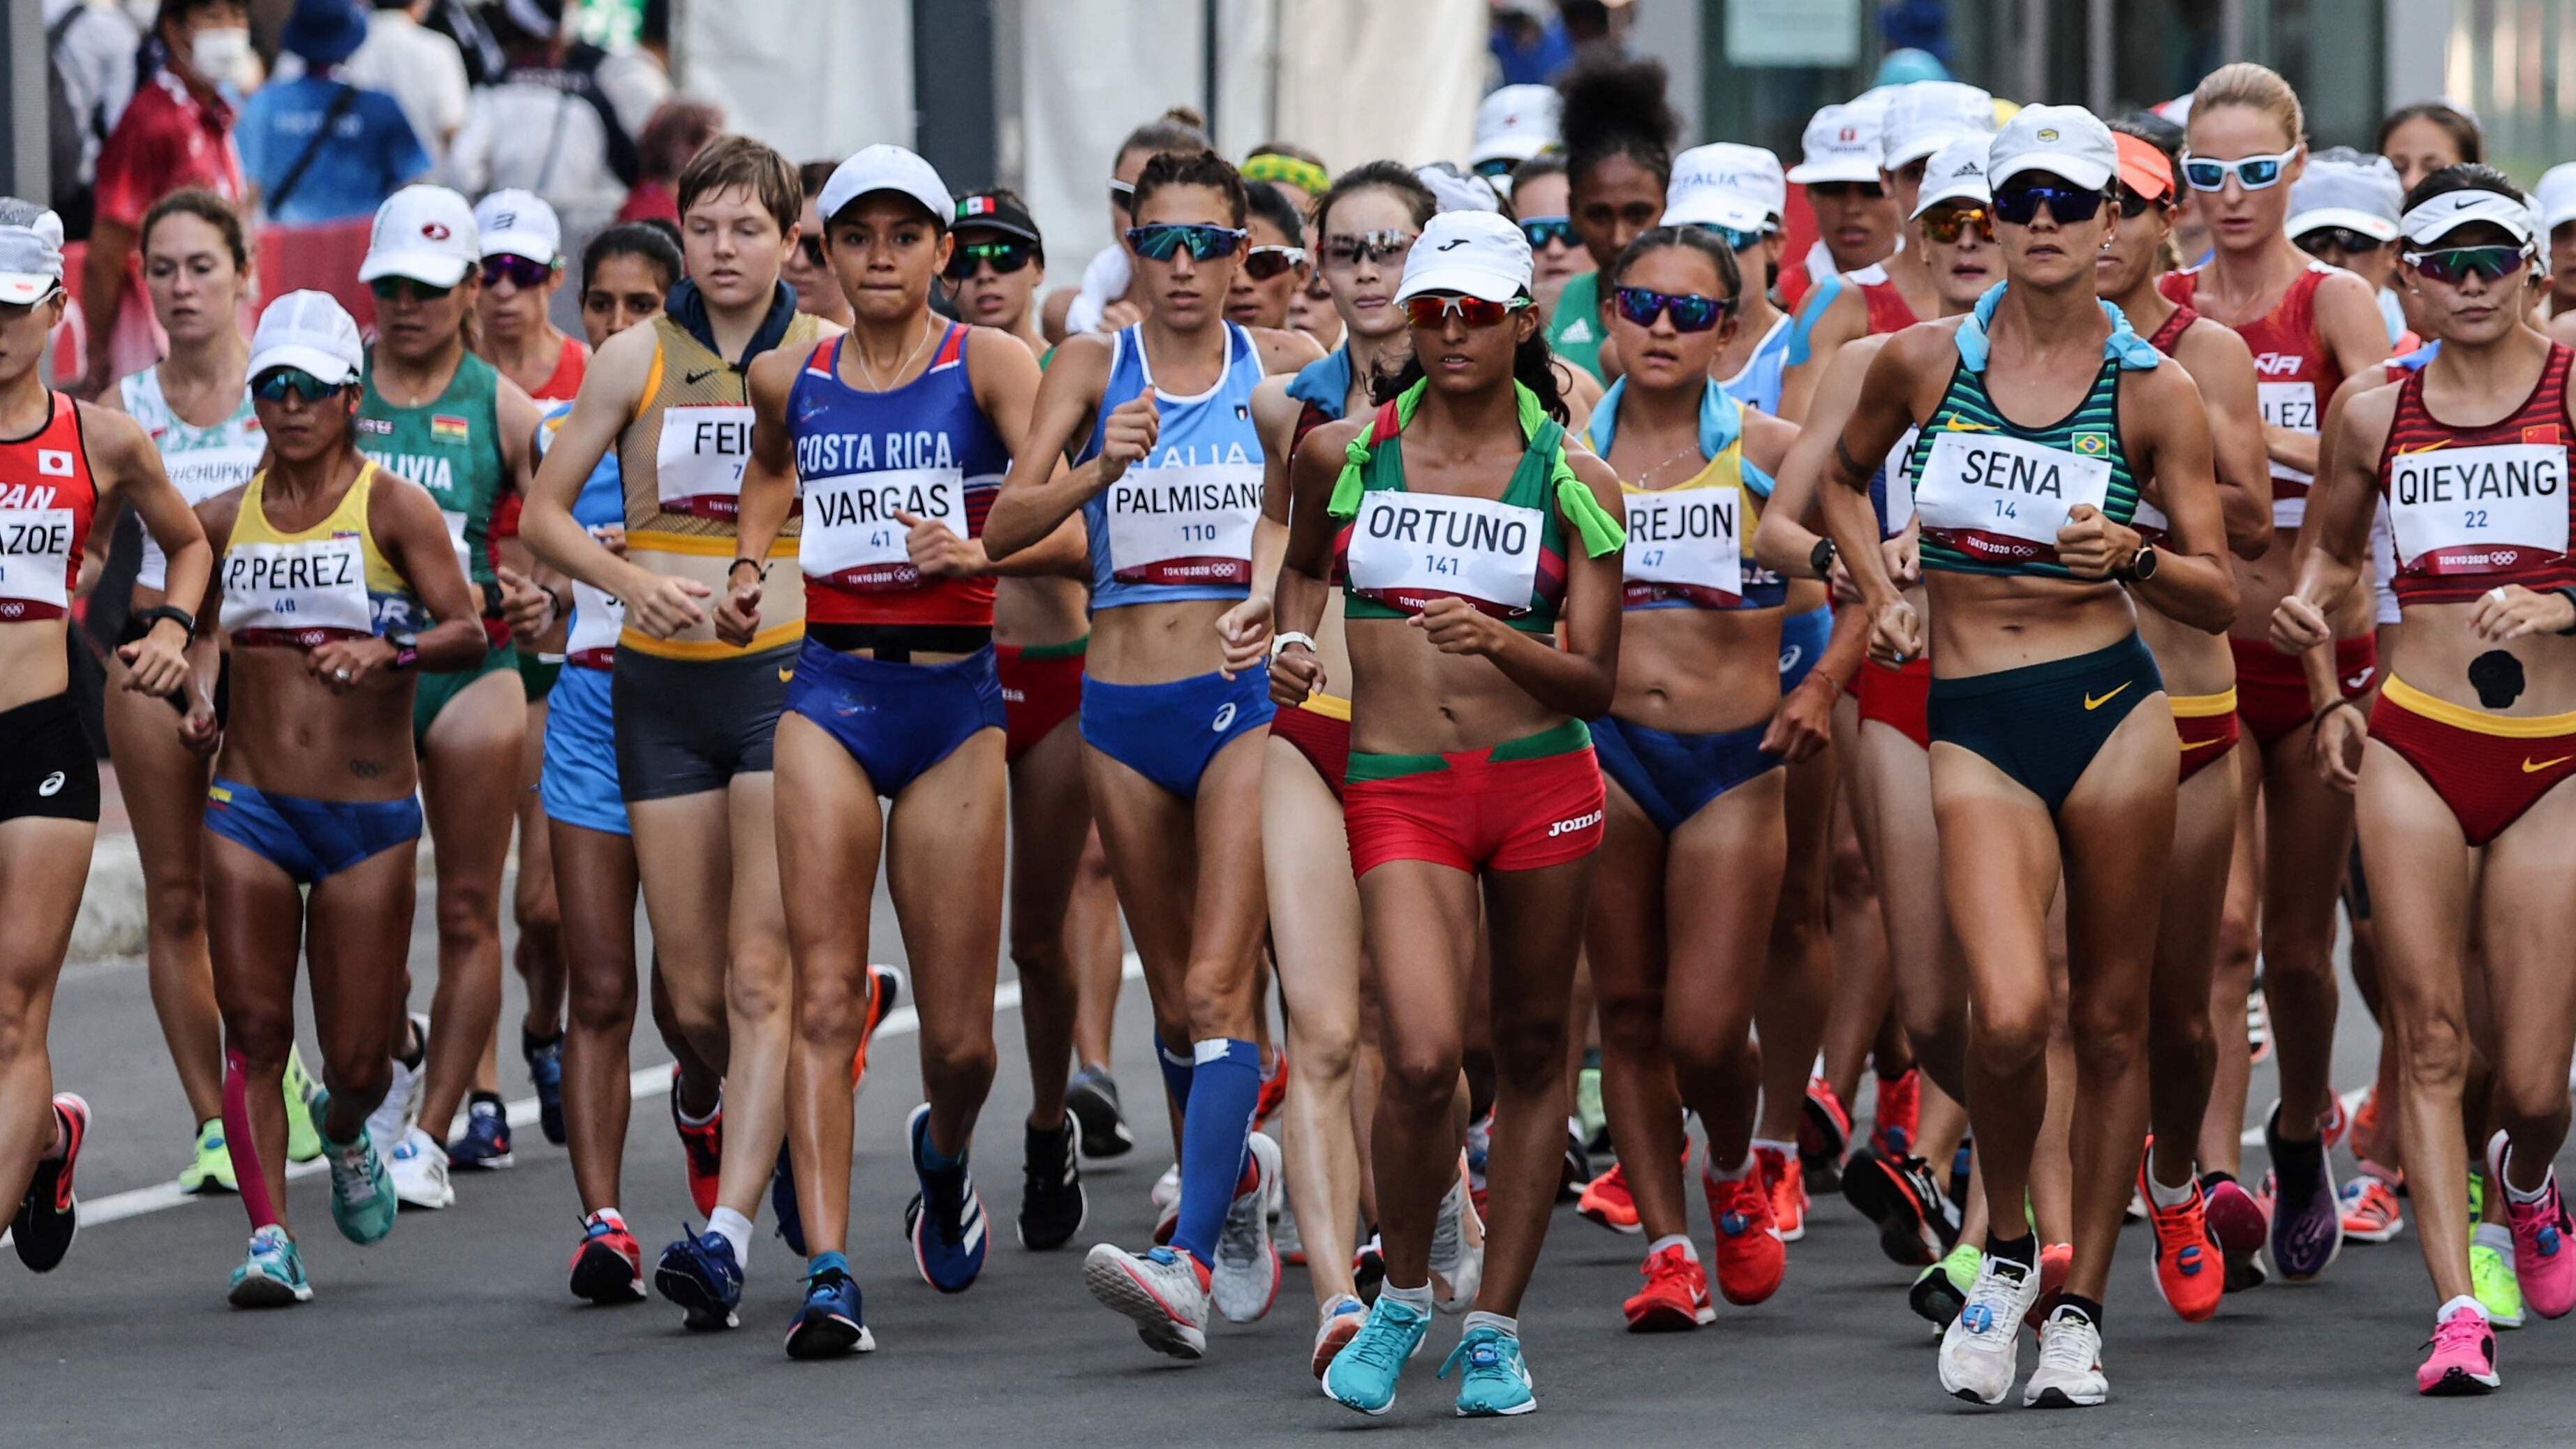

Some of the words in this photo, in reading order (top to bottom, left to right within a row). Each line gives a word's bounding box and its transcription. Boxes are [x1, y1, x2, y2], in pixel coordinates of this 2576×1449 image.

[695, 422, 755, 454] FEI
[798, 433, 875, 473] COSTA
[886, 431, 952, 468] RICA
[167, 462, 257, 482] SHCHUPKI
[1961, 450, 2061, 499] SENA
[2399, 460, 2558, 505] QIEYANG
[816, 484, 950, 528] VARGAS
[1116, 482, 1263, 513] PALMISAN
[1994, 499, 2017, 519] 14
[1629, 503, 1733, 543] REJON
[2465, 511, 2487, 528] 22
[871, 530, 892, 547] 41
[1182, 524, 1215, 541] 110
[1369, 505, 1527, 556] ORTUNO
[1967, 536, 1988, 551] TOKYO
[1988, 544, 2011, 554] 2020
[1426, 555, 1459, 577] 141
[1643, 550, 1664, 566] 47
[2439, 556, 2467, 565] TOKYO
[2468, 554, 2489, 564] 2020
[229, 553, 353, 590] P.PEREZ
[847, 574, 872, 584] TOKYO
[873, 572, 893, 583] 2020
[1163, 566, 1190, 577] TOKYO
[1190, 566, 1210, 576] 2020
[274, 597, 296, 614] 48
[1399, 596, 1426, 609] TOKYO
[1548, 809, 1602, 837] Joma
